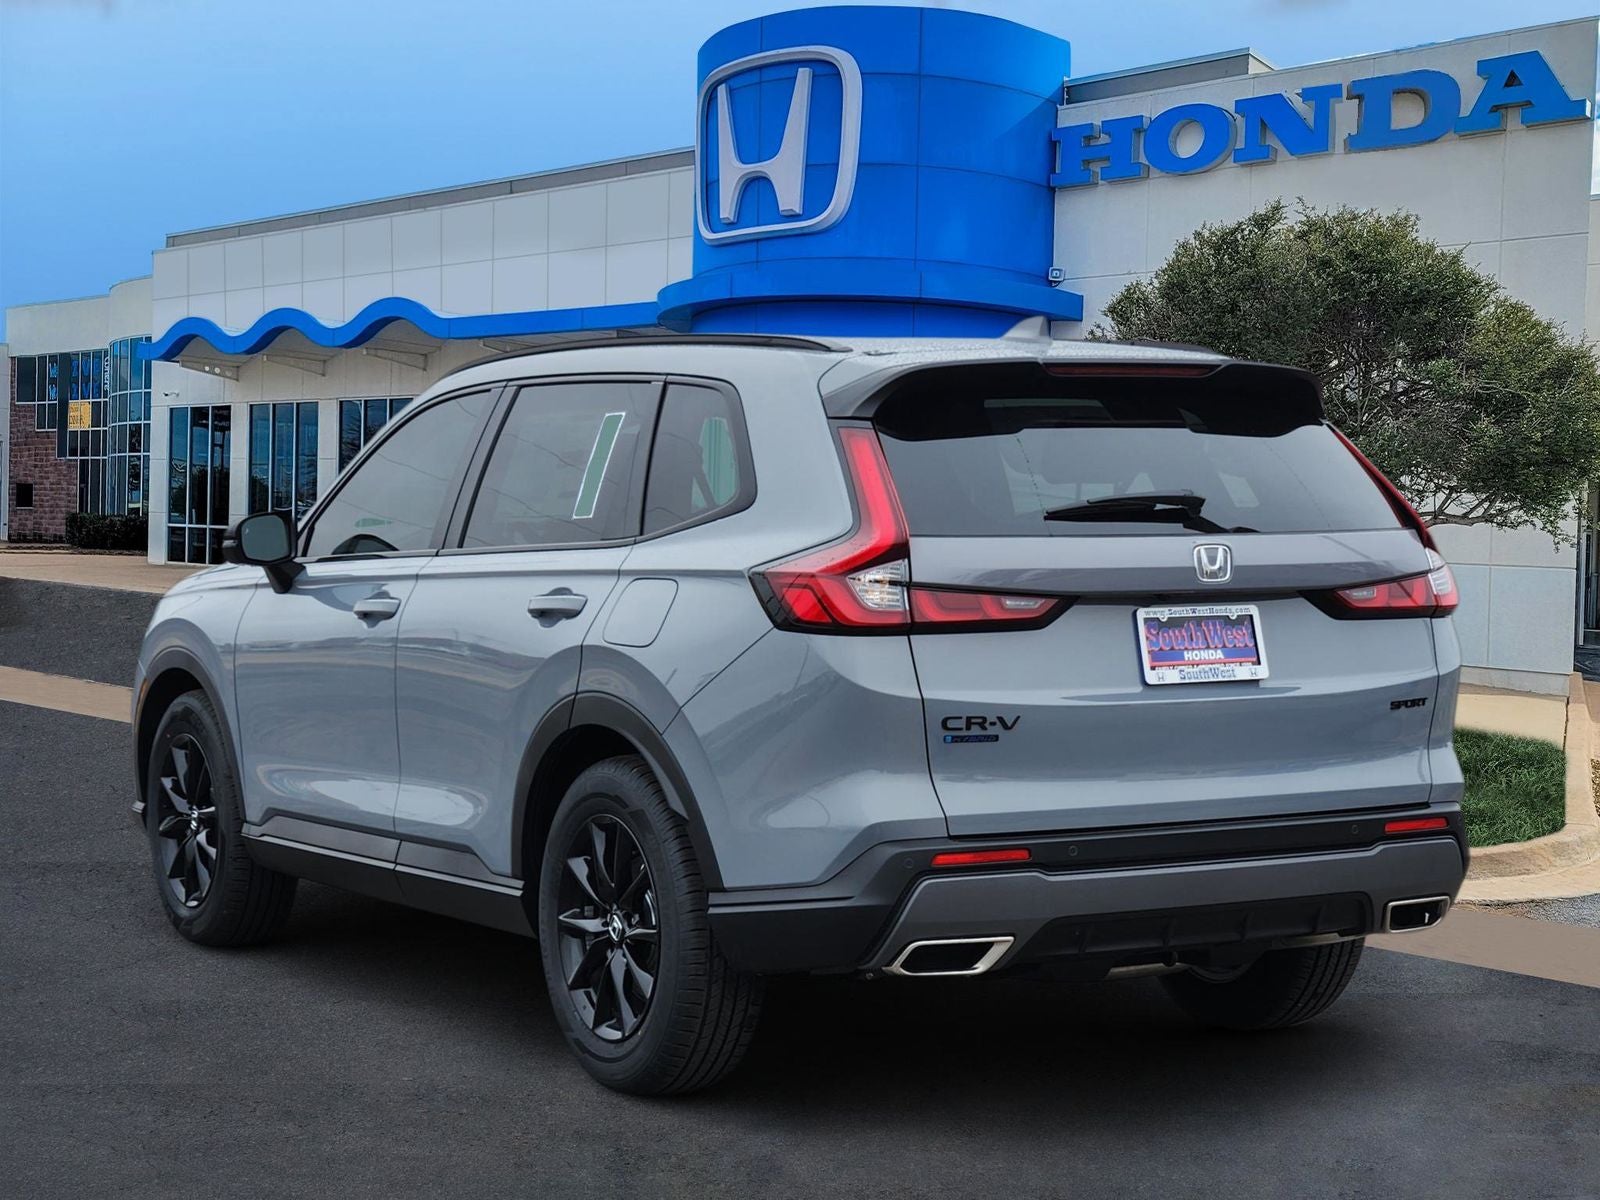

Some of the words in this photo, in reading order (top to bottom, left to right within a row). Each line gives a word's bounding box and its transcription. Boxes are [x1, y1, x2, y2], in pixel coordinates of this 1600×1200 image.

[1051, 50, 1591, 188] HONDA
[1144, 607, 1251, 617] www.SouthWestHonda.com
[1144, 620, 1254, 650] SouthWest
[1183, 650, 1225, 661] HONDA
[1178, 668, 1237, 680] SouthWest
[1390, 697, 1428, 710] SPORT
[941, 715, 1021, 731] CR-V
